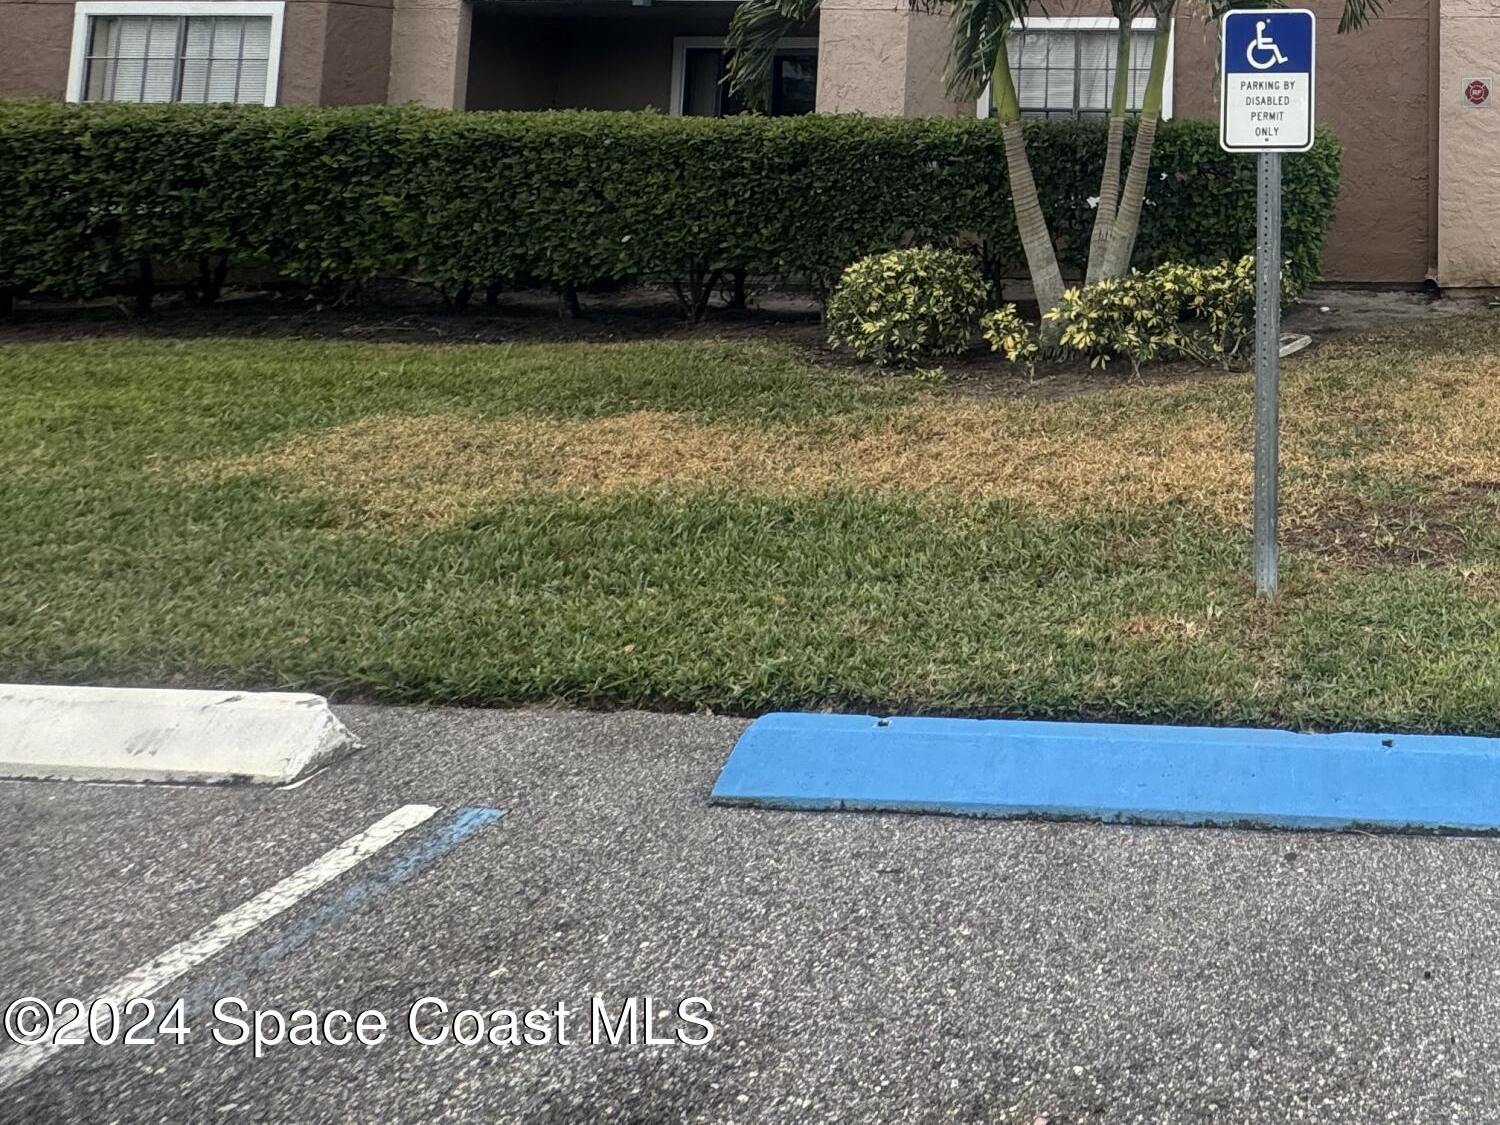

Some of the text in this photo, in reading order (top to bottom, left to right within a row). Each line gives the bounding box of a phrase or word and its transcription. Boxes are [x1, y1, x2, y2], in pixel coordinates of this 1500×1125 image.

[1240, 80, 1296, 91] PARKING BY
[1245, 95, 1290, 106] DISABLED
[1250, 111, 1284, 121] PERMIT
[1255, 127, 1280, 137] ONLY
